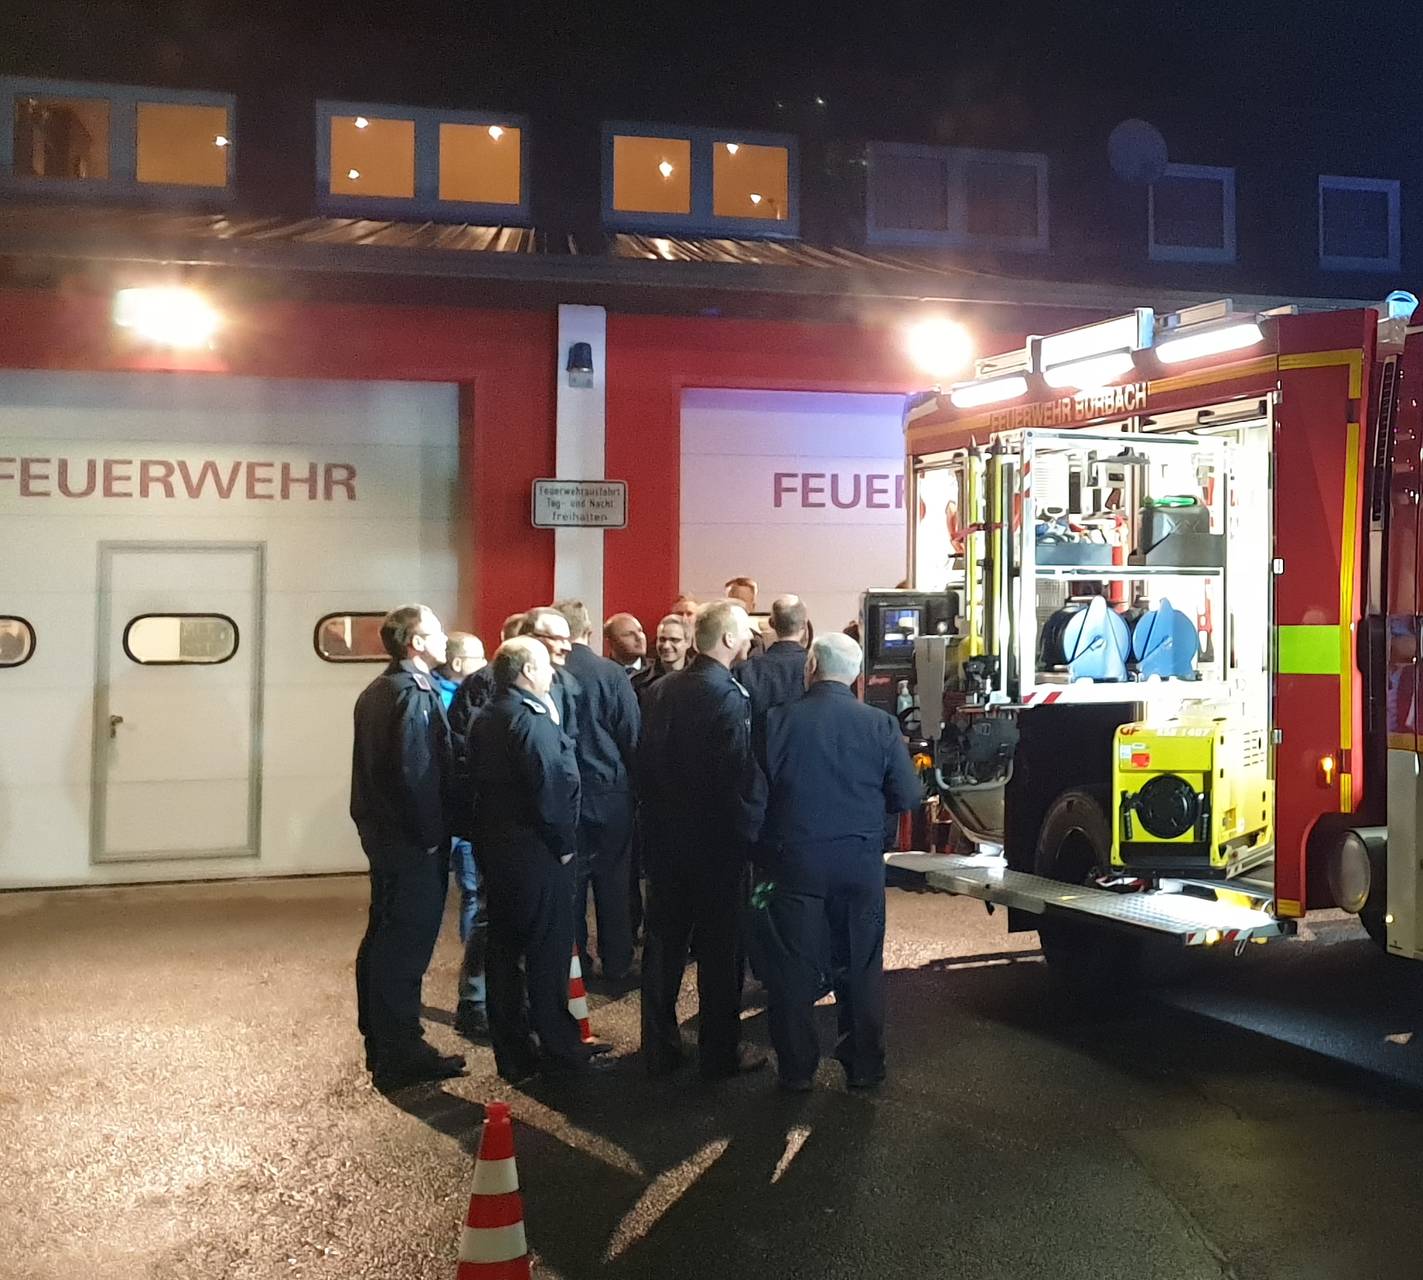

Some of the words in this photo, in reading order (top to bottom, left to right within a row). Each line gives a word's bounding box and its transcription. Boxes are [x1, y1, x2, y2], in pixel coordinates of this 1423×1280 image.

[990, 397, 1072, 432] FEUERWEHR
[1075, 381, 1148, 420] BURBACH
[589, 498, 614, 509] Nacht
[552, 510, 609, 522] freihalten
